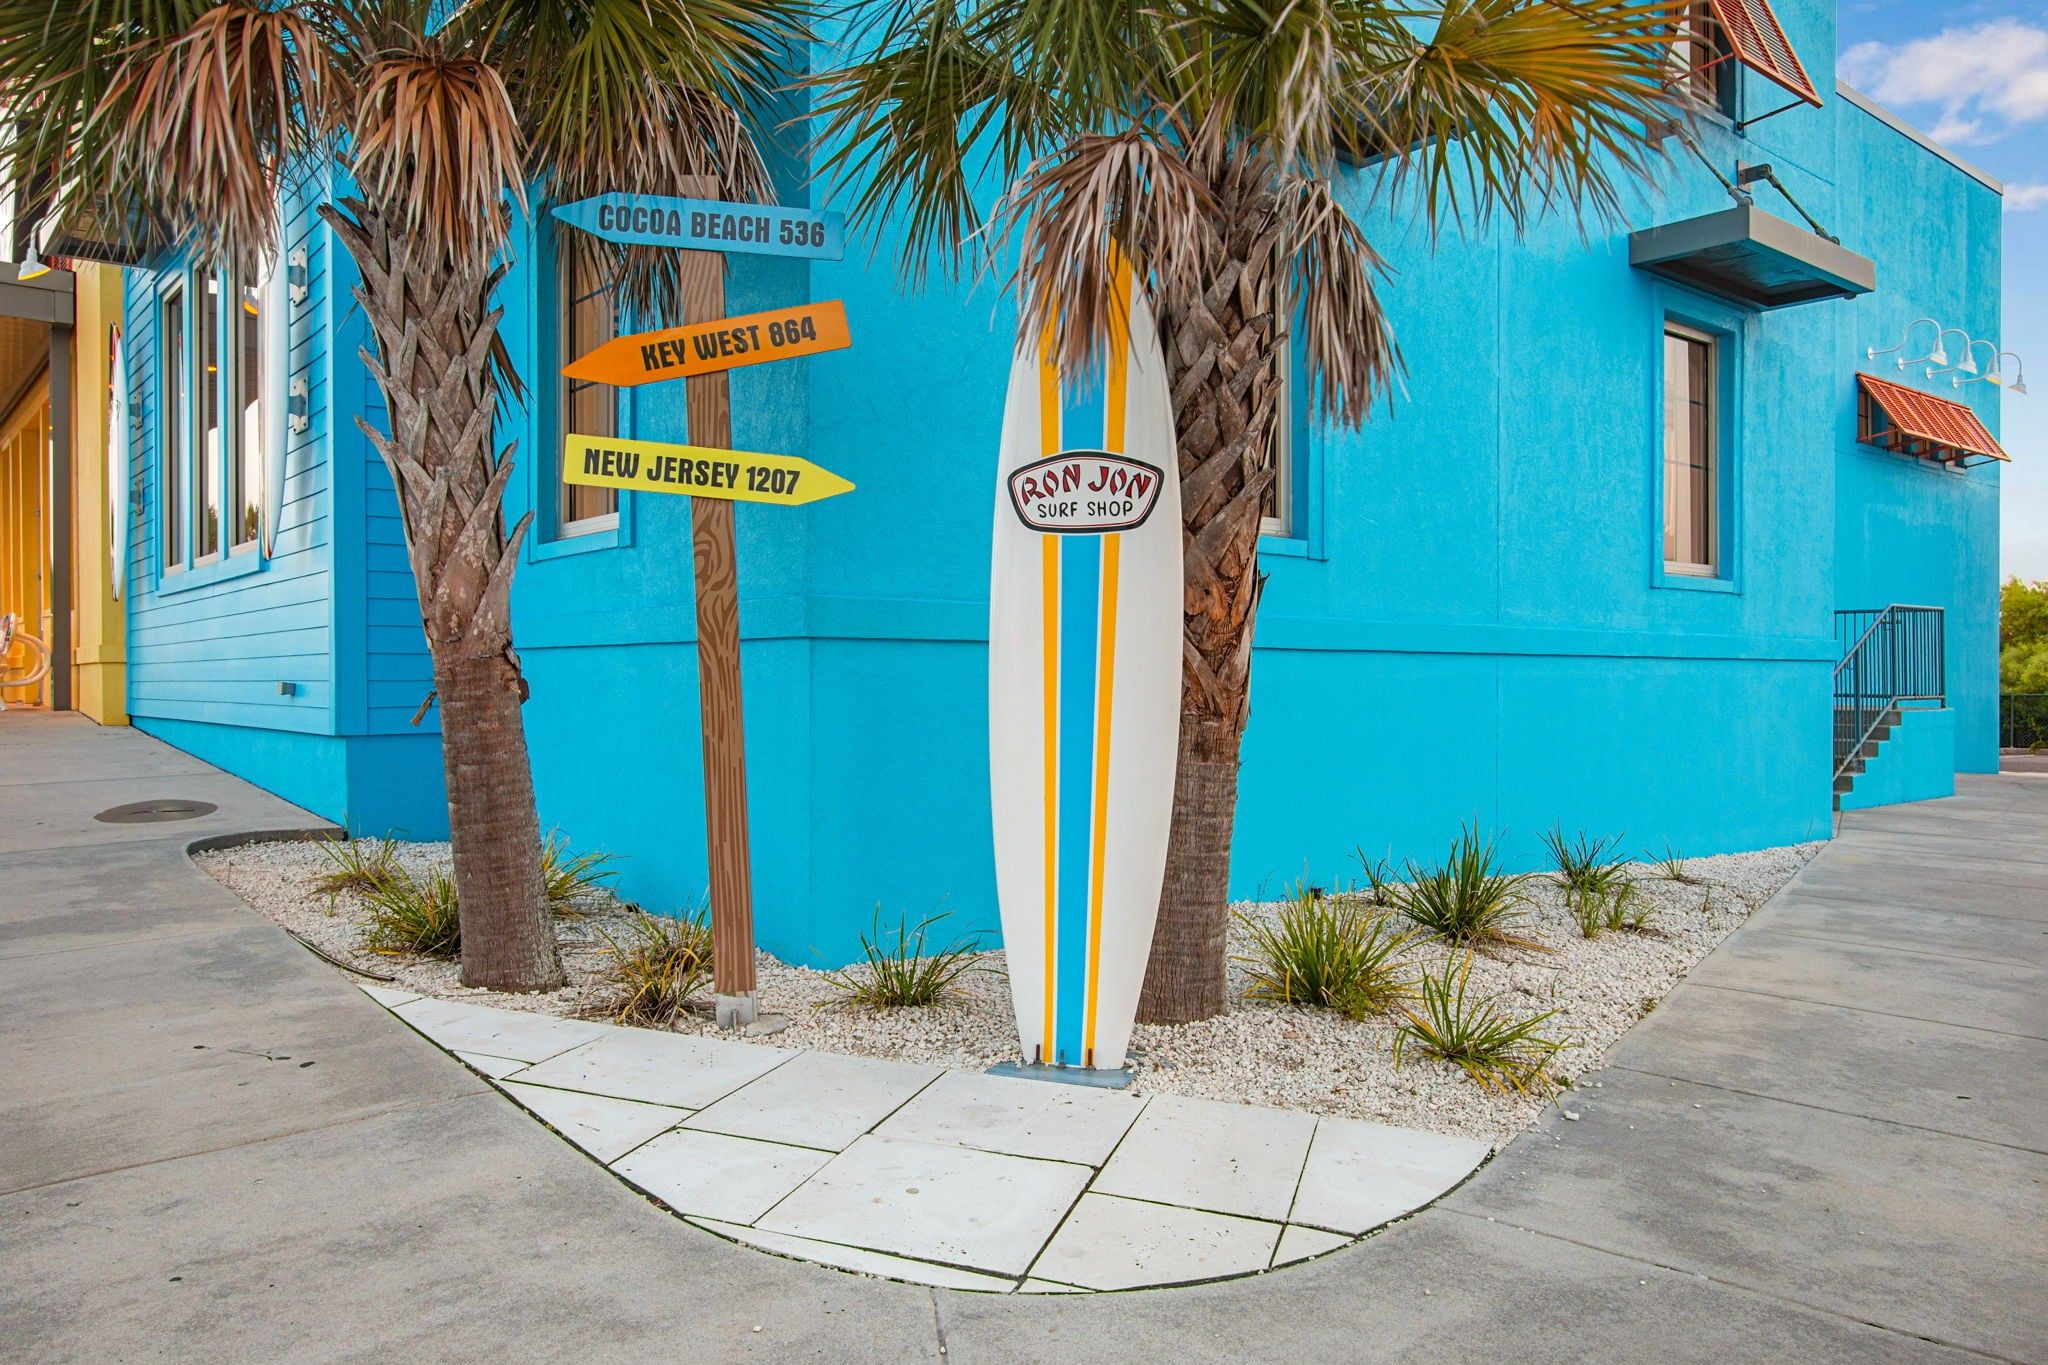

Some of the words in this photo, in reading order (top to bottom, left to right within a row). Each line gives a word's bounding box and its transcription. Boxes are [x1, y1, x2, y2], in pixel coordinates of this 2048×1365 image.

[598, 204, 681, 236] COCOA
[690, 211, 770, 243] BEACH
[779, 219, 825, 247] 536
[640, 339, 686, 371] KEY
[693, 325, 761, 360] WEST
[768, 316, 817, 348] 864
[583, 448, 640, 478] NEW
[646, 455, 740, 489] JERSEY
[746, 465, 800, 495] 1207
[1021, 464, 1081, 506] RON
[1087, 465, 1152, 500] JON
[1037, 501, 1078, 518] SURF
[1087, 500, 1133, 517] SHOP
